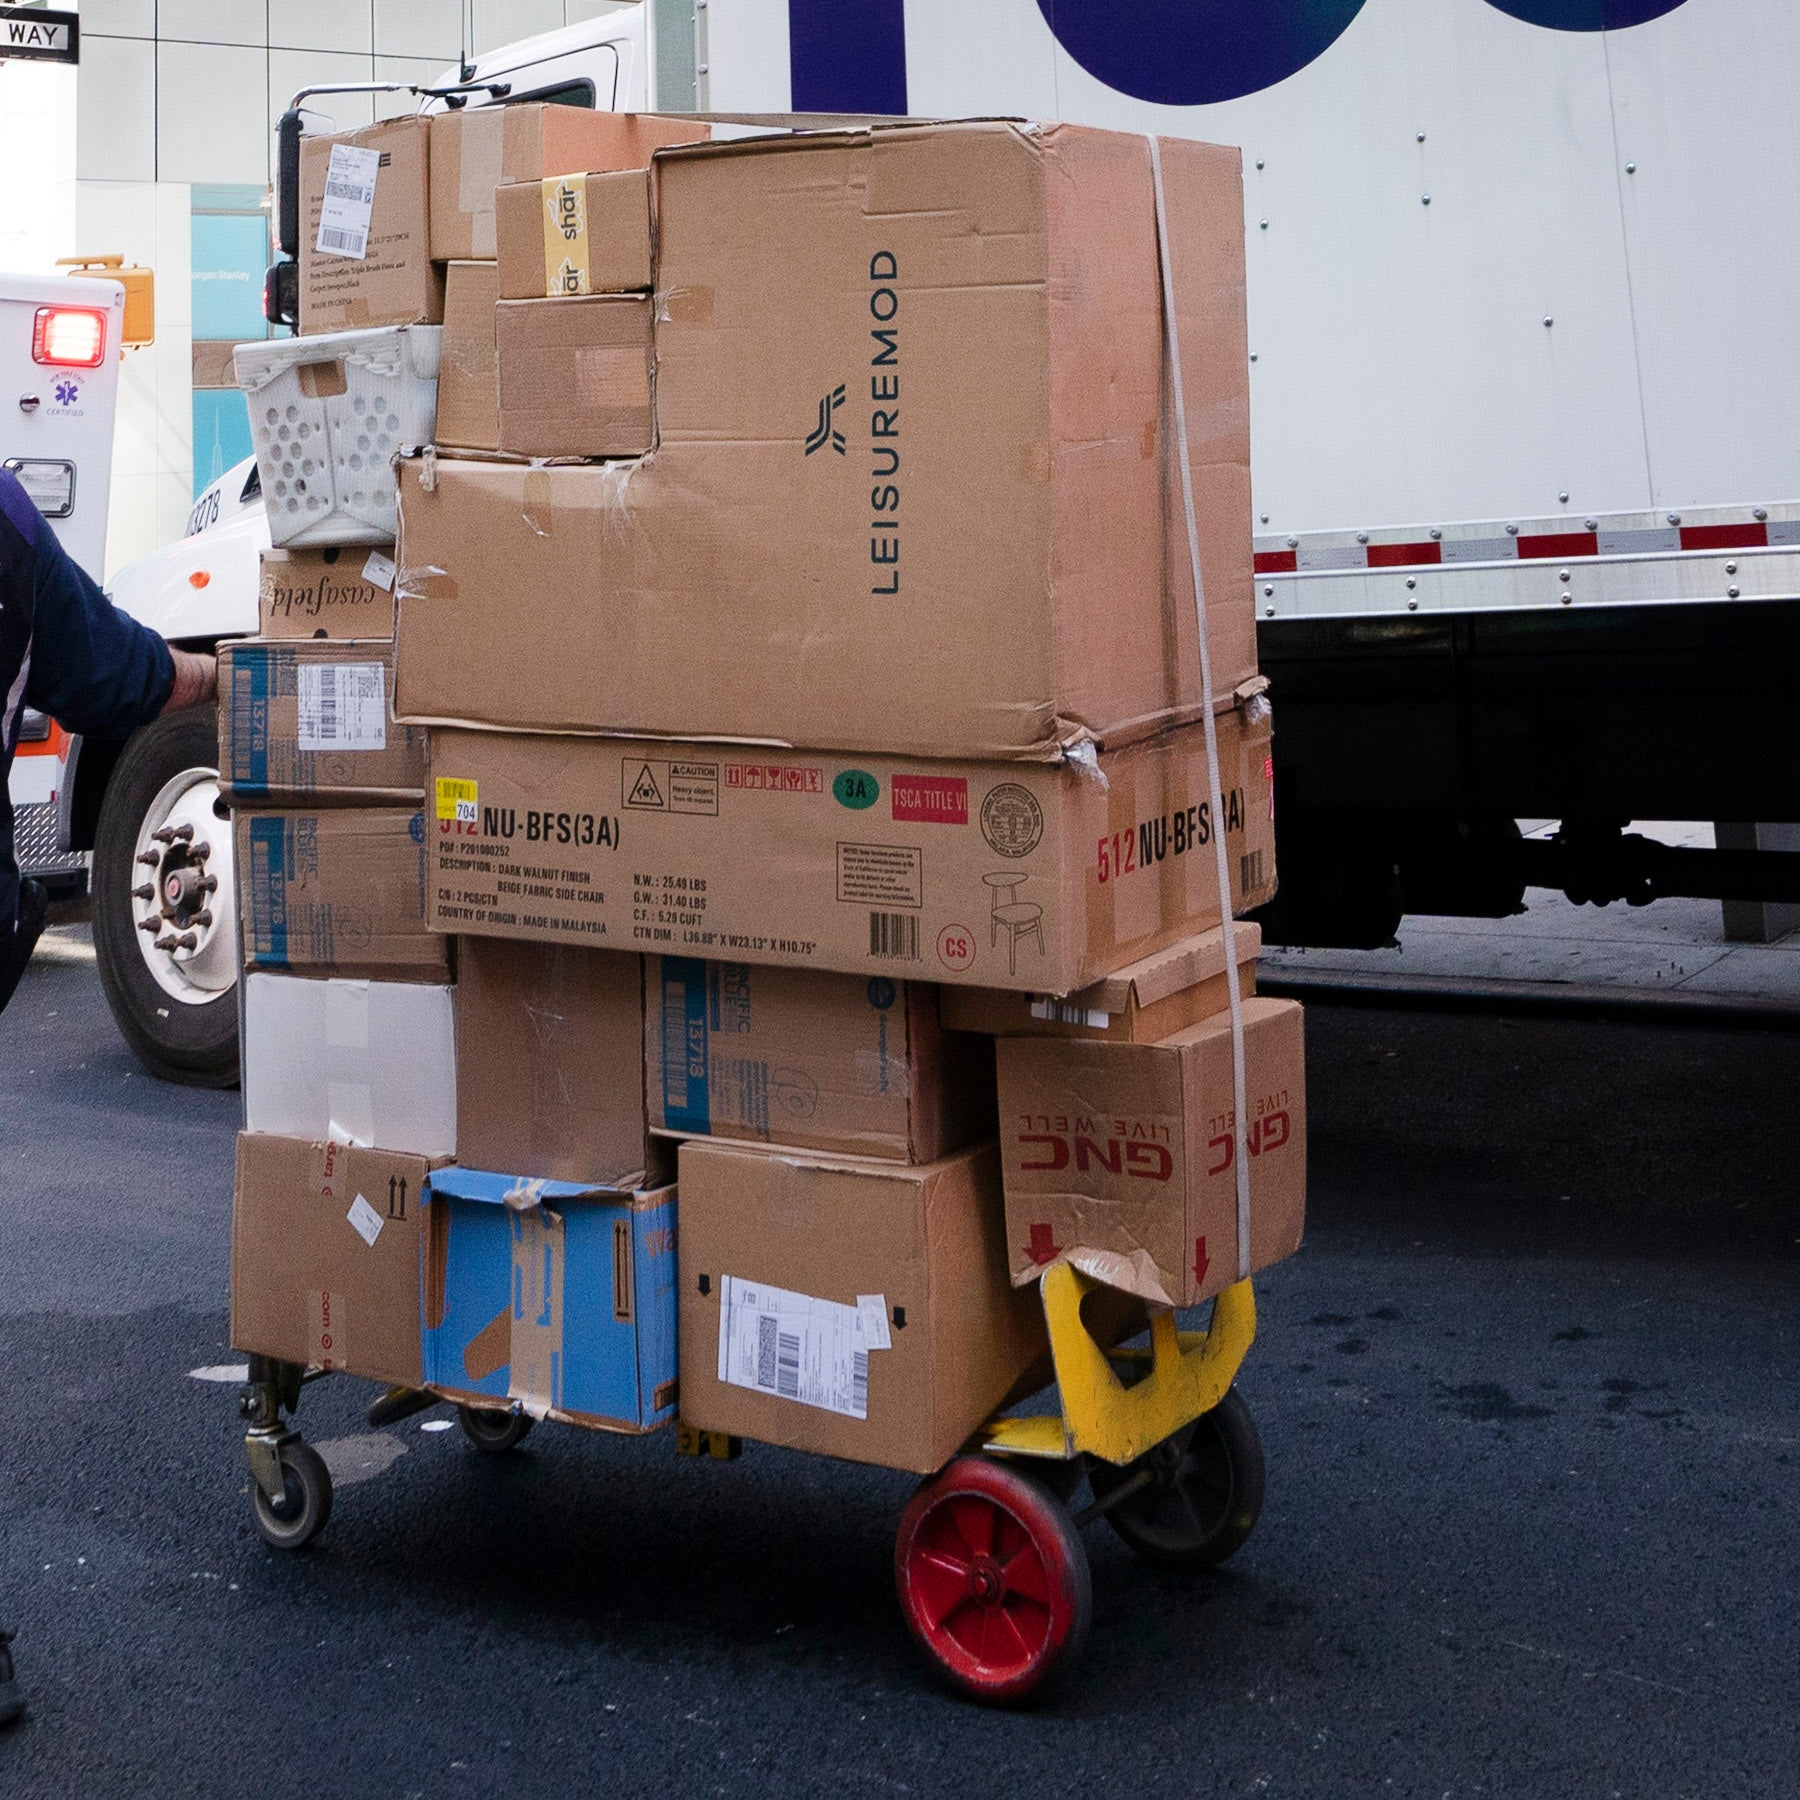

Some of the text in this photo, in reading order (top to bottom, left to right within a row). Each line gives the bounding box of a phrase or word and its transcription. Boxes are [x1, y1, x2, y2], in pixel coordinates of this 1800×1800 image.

[9, 23, 59, 47] WAY
[870, 249, 900, 595] LEISUREMOD
[271, 575, 375, 617] casafield
[252, 698, 265, 752] 13718
[679, 766, 716, 778] CAUTION
[673, 785, 692, 796] Heavy
[845, 777, 866, 799] 3A
[894, 787, 922, 808] TSCA
[924, 790, 953, 810] TITLE
[457, 803, 476, 819] 704
[483, 806, 620, 850] NU-BFS(3A)
[1097, 827, 1135, 884] 512
[439, 857, 591, 884] DESCRIPTION DARK WALNUT FINISH
[497, 881, 605, 904] BEIGE FABRIC SIDE CHAIR
[662, 875, 687, 890] 25.49
[689, 878, 707, 891] LBS
[271, 871, 283, 925] 13718
[457, 890, 463, 901] 2
[662, 894, 687, 907] 31.40
[689, 897, 707, 910] LBS
[438, 904, 607, 934] COUNTRY OF ORIGIN MADE IN MALAYSIA
[679, 914, 702, 926] CUFT
[633, 927, 650, 939] CTN
[653, 929, 672, 941] DIM
[720, 933, 726, 946] X
[770, 938, 777, 950] X
[945, 937, 967, 958] CS
[688, 1018, 704, 1078] 13718
[1256, 1089, 1288, 1115] LIVE
[1019, 1115, 1170, 1144] LIVE WELL
[1018, 1134, 1173, 1182] GNC
